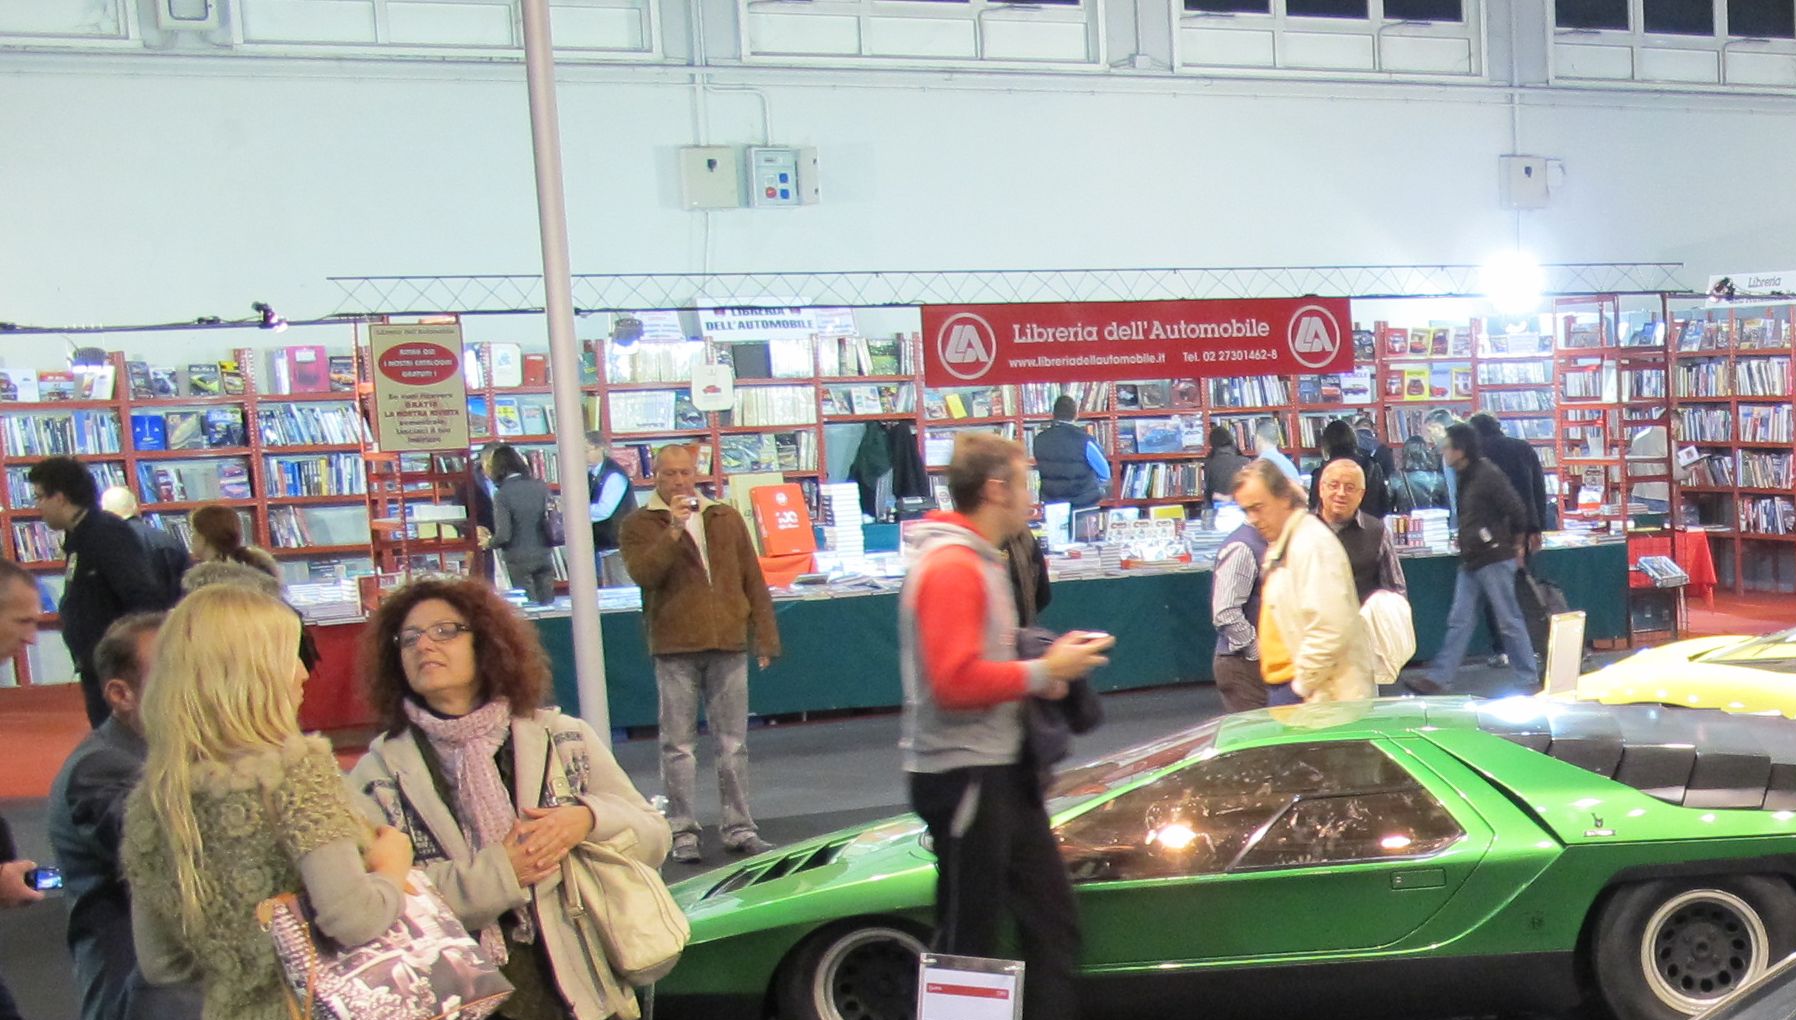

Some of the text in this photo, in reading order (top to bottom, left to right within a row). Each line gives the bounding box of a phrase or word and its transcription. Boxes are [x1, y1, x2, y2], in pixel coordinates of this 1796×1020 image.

[1747, 276, 1782, 288] Libreria
[705, 320, 814, 331] DELL'AUTOMOBILE
[1013, 318, 1271, 343] Libreria dell'Automobile
[1008, 349, 1278, 368] www.libreriadellautomobile.it Tel. 02 27301462-8
[404, 401, 438, 409] GRATIS
